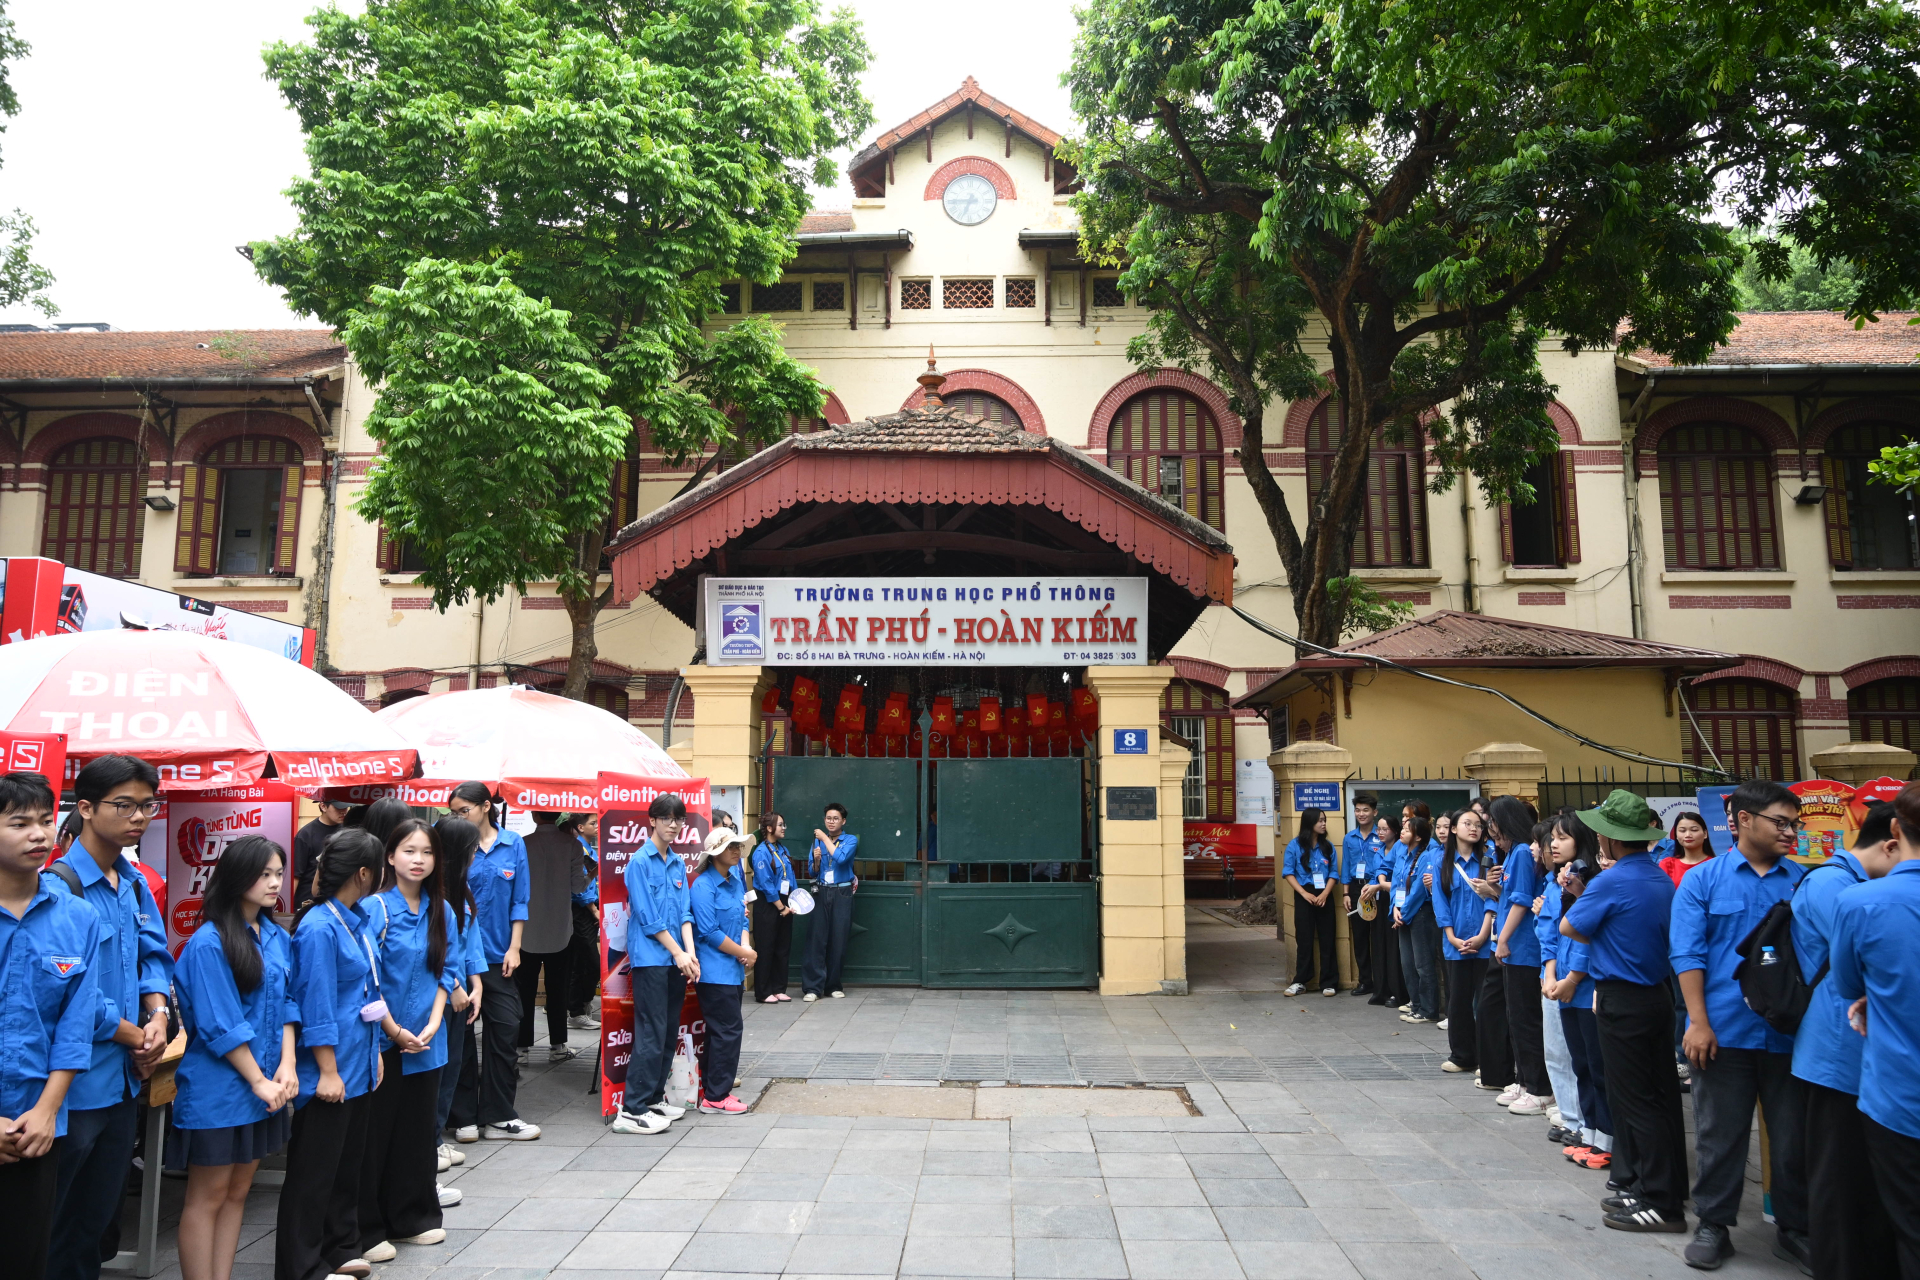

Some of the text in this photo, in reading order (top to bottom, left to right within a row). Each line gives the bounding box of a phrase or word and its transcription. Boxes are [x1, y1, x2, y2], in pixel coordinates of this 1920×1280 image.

[795, 581, 1115, 604] TRƯỜNG TRUNG HỌC PHỔ THÔNG
[770, 603, 858, 643] TRẦN
[867, 607, 930, 643] PHÚ
[954, 608, 1044, 643] HOÀN
[1051, 603, 1138, 643] KIẾM
[777, 652, 793, 660] ĐC:
[796, 649, 809, 660] SỐ
[811, 652, 816, 660] 8
[819, 652, 834, 660] HAI
[838, 650, 851, 660] BÀ
[853, 651, 885, 660] TRƯNG
[893, 650, 920, 660] HOÀN
[922, 649, 945, 660] KIẾM
[953, 650, 967, 660] HÀ
[969, 650, 985, 662] NỘI
[1080, 652, 1091, 660] 04
[1093, 652, 1113, 660] 3825
[67, 668, 209, 703] ĐIỆN
[40, 710, 228, 744] THOẠI
[1123, 732, 1136, 746] 8
[349, 784, 453, 803] dienthoai
[1800, 795, 1818, 804] INH
[226, 808, 262, 831] TÙNG
[606, 850, 627, 861] ĐIỆN
[607, 1029, 632, 1047] Sửa
